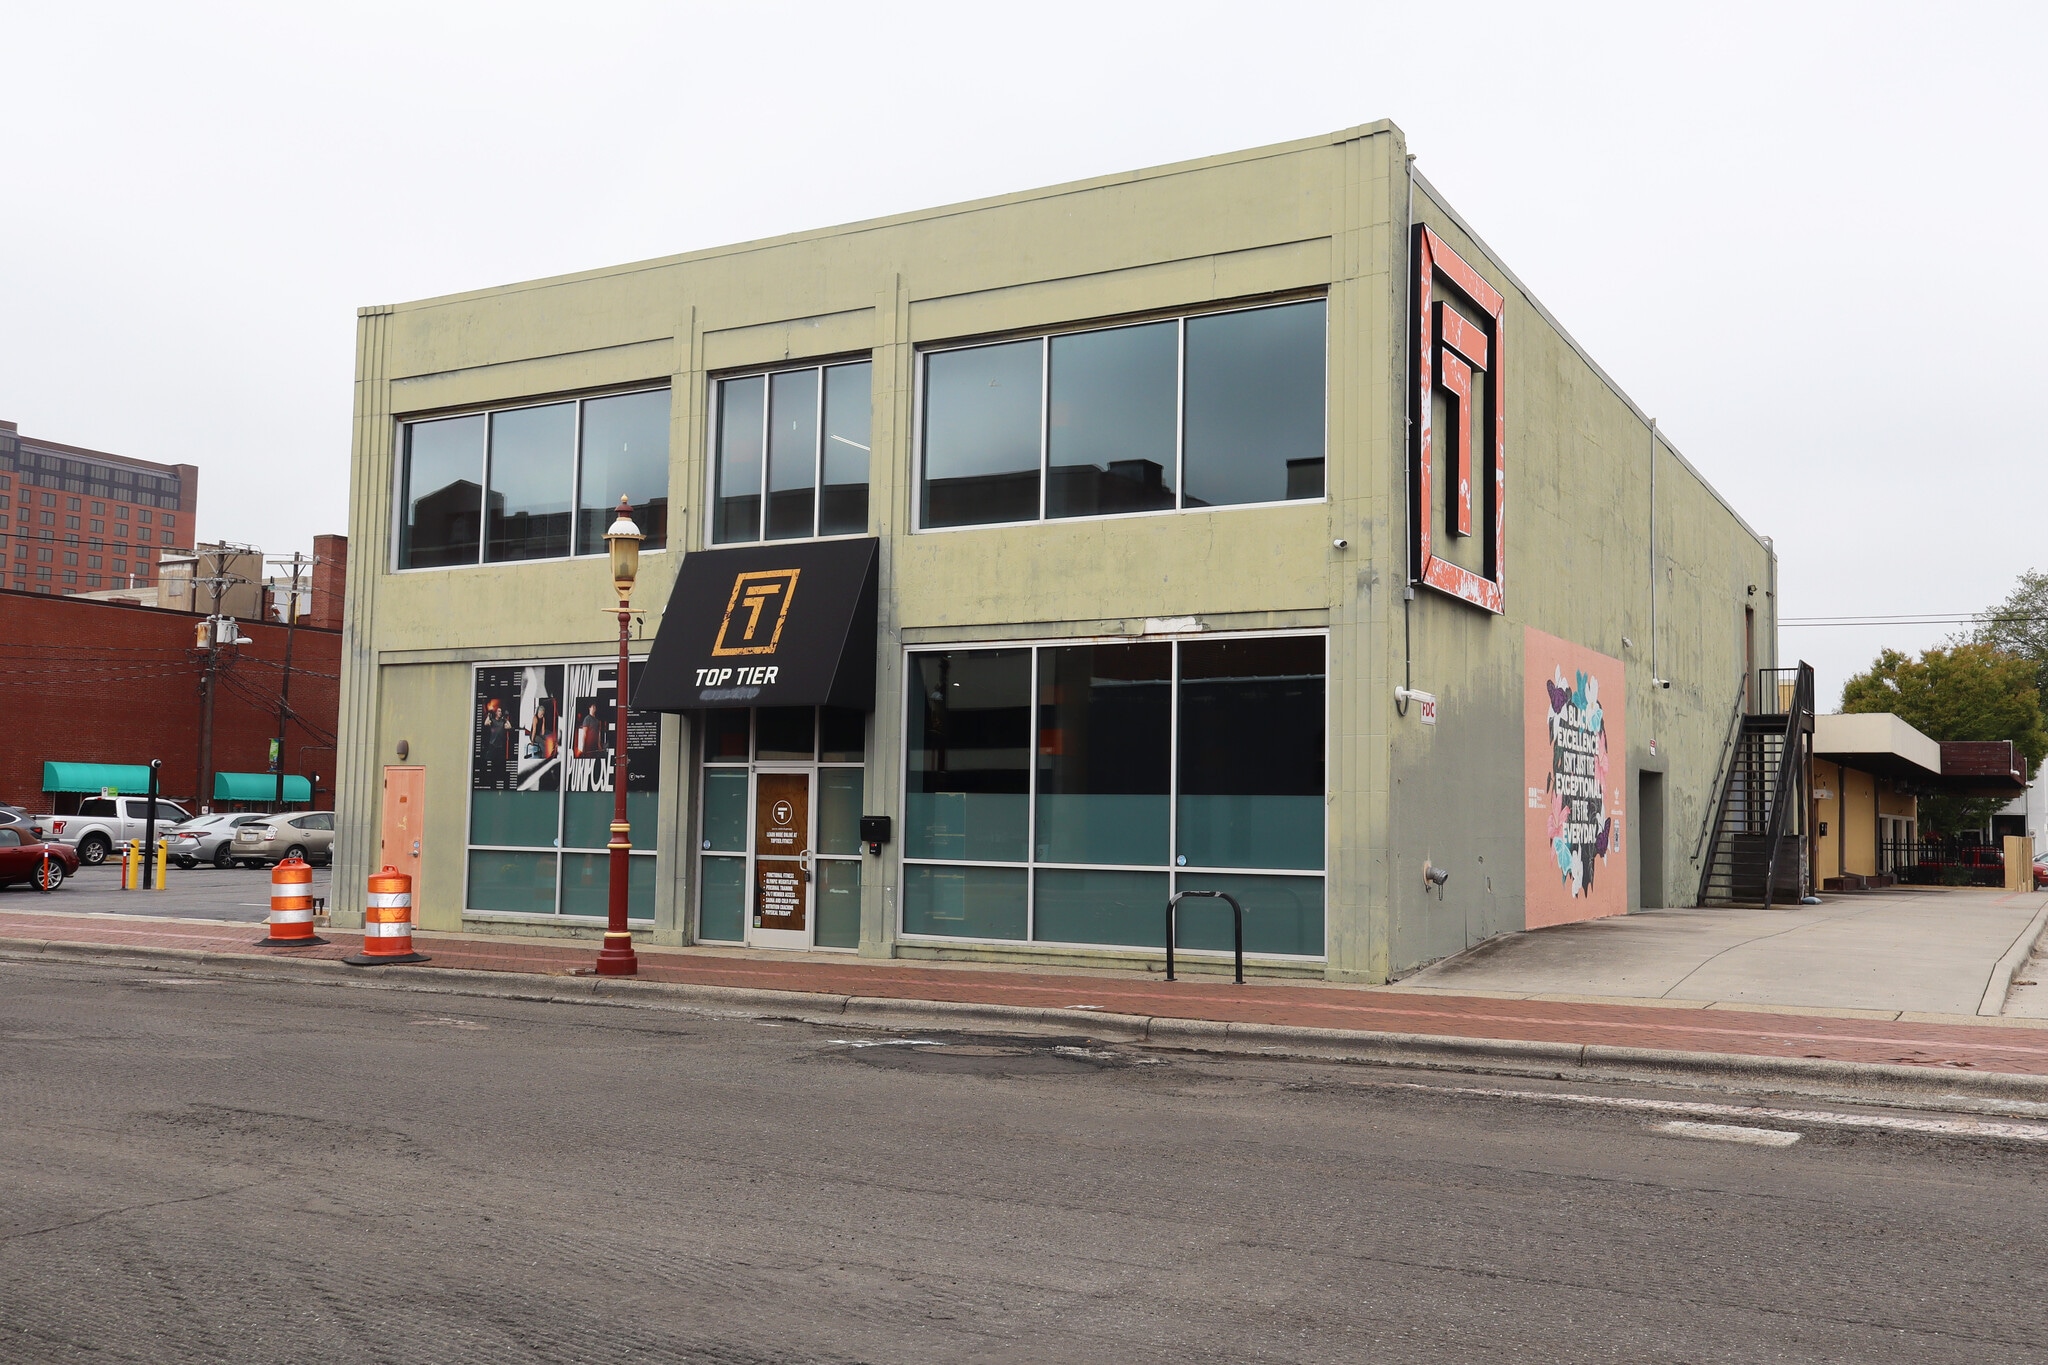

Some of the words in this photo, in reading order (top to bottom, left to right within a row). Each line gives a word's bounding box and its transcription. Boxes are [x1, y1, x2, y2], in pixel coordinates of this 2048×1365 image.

[695, 668, 732, 687] TOP
[736, 666, 779, 685] TIER
[1422, 702, 1435, 718] FDC
[1557, 727, 1600, 756] EXCELLENCE
[565, 749, 614, 792] PURPOSE
[1576, 754, 1586, 776] JUST
[1586, 756, 1595, 777] THE
[1580, 800, 1588, 822] THE
